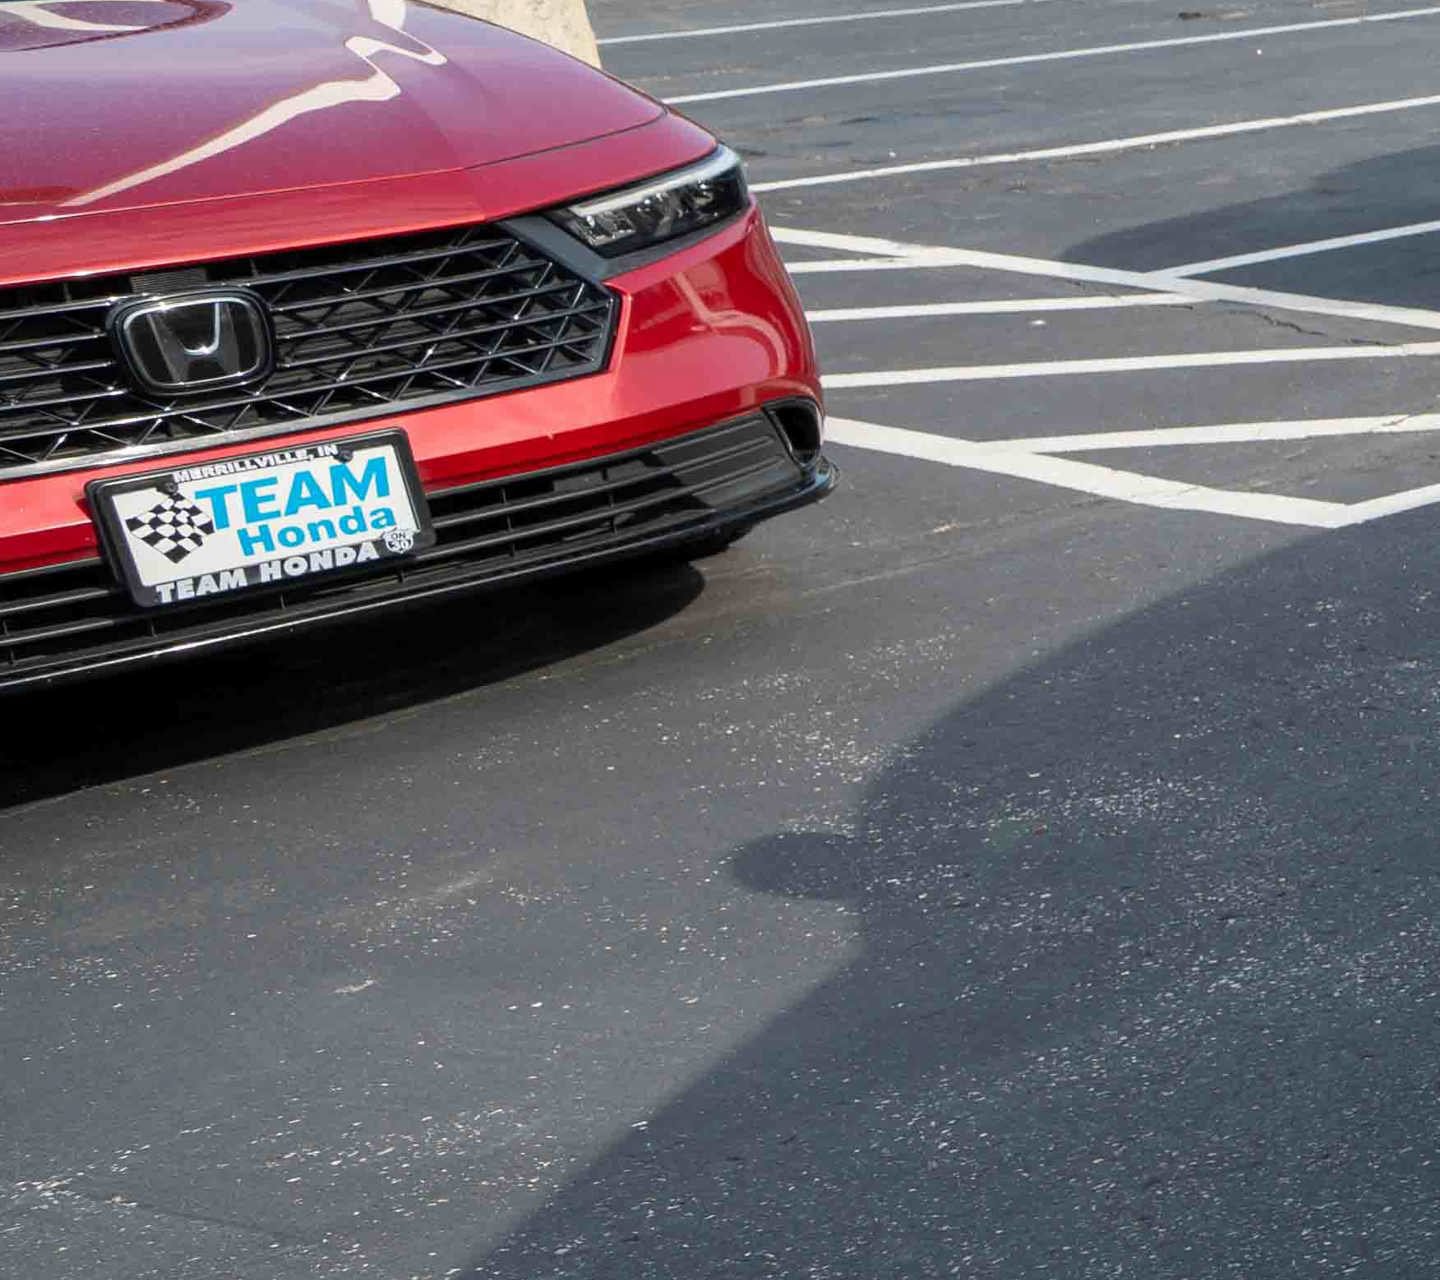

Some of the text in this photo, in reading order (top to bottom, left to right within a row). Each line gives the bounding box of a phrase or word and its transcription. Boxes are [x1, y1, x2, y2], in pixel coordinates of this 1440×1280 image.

[173, 444, 339, 483] MERRILLVILLE, IN
[195, 456, 391, 529] TEAM
[239, 506, 397, 556] Honda
[155, 542, 380, 603] TEAM HONDA
